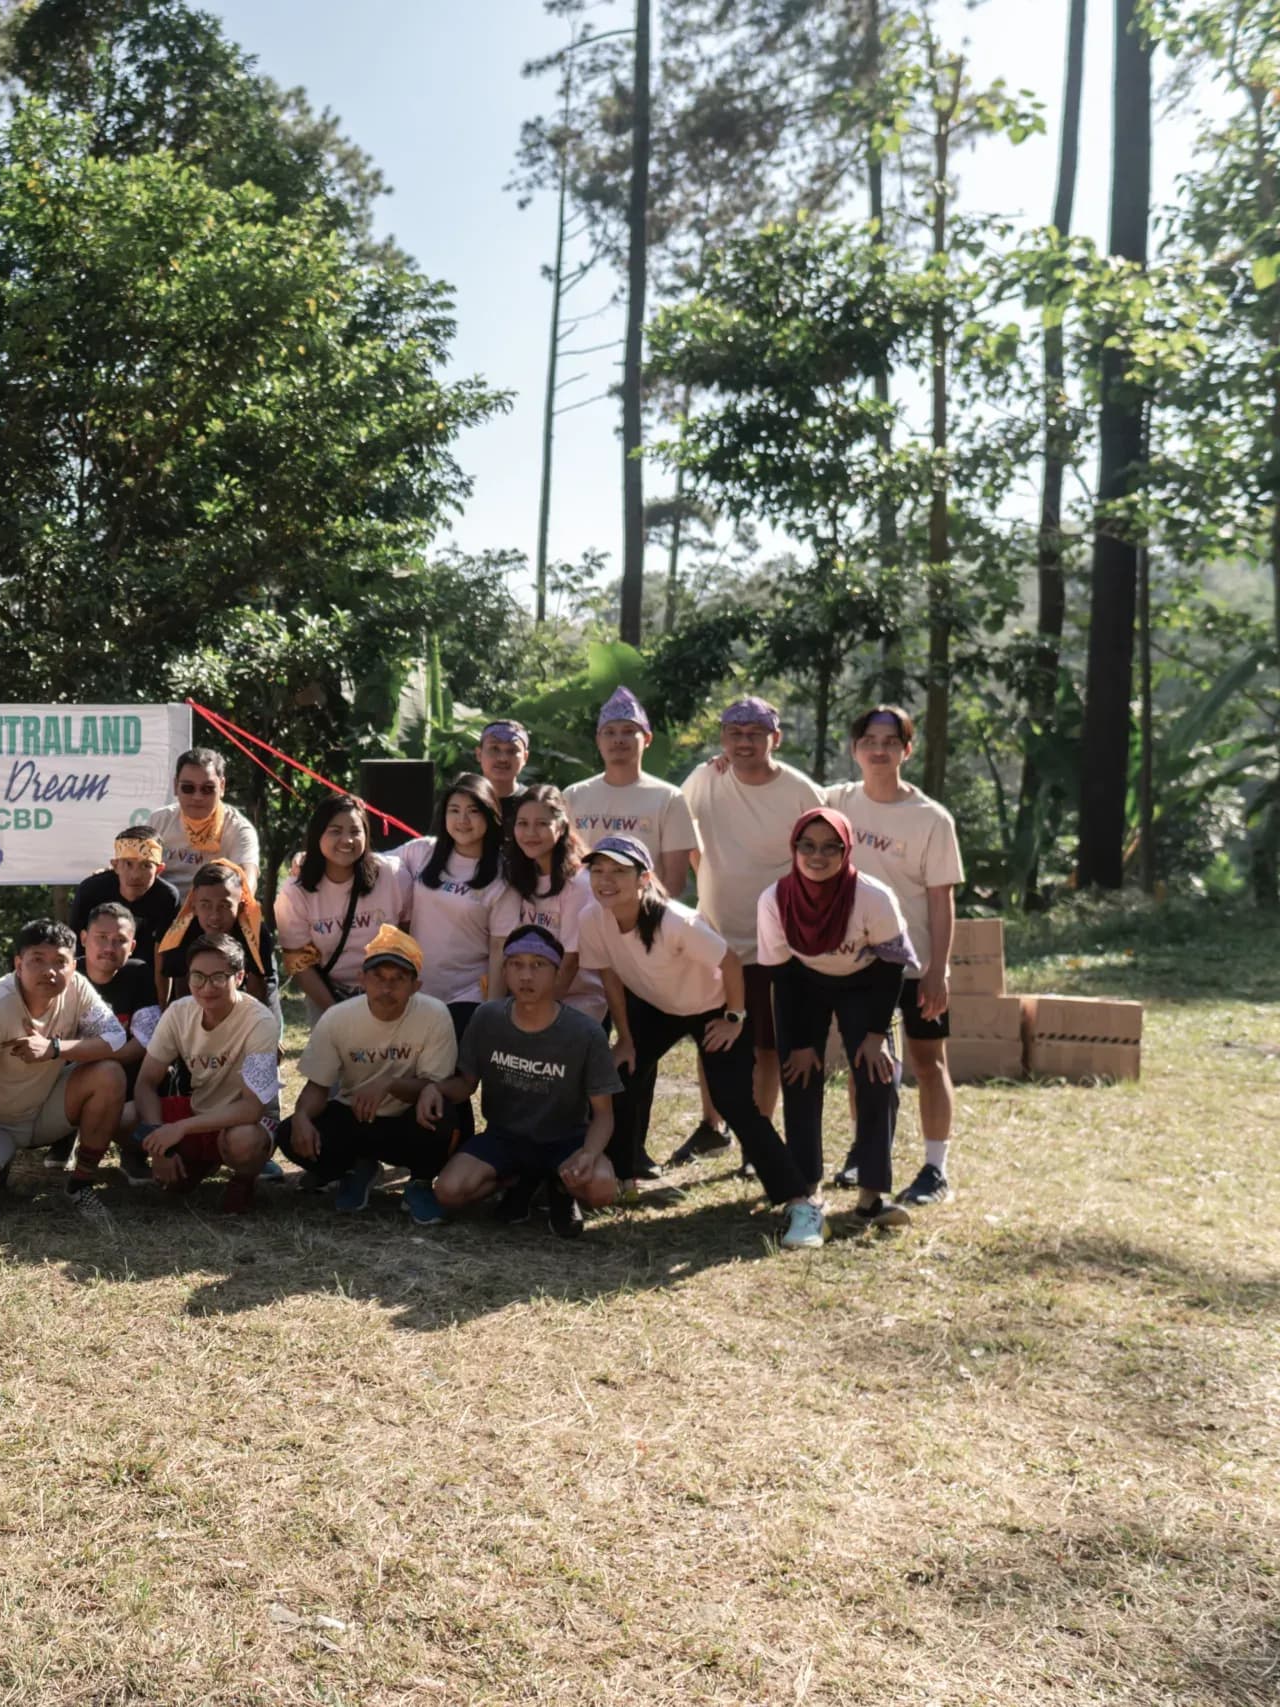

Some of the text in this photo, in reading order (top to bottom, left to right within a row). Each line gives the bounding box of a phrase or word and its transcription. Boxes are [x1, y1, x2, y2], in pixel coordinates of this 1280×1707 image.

[4, 760, 111, 803] Dream
[574, 817, 637, 831] SKY VIEW
[489, 1050, 566, 1079] AMERICAN
